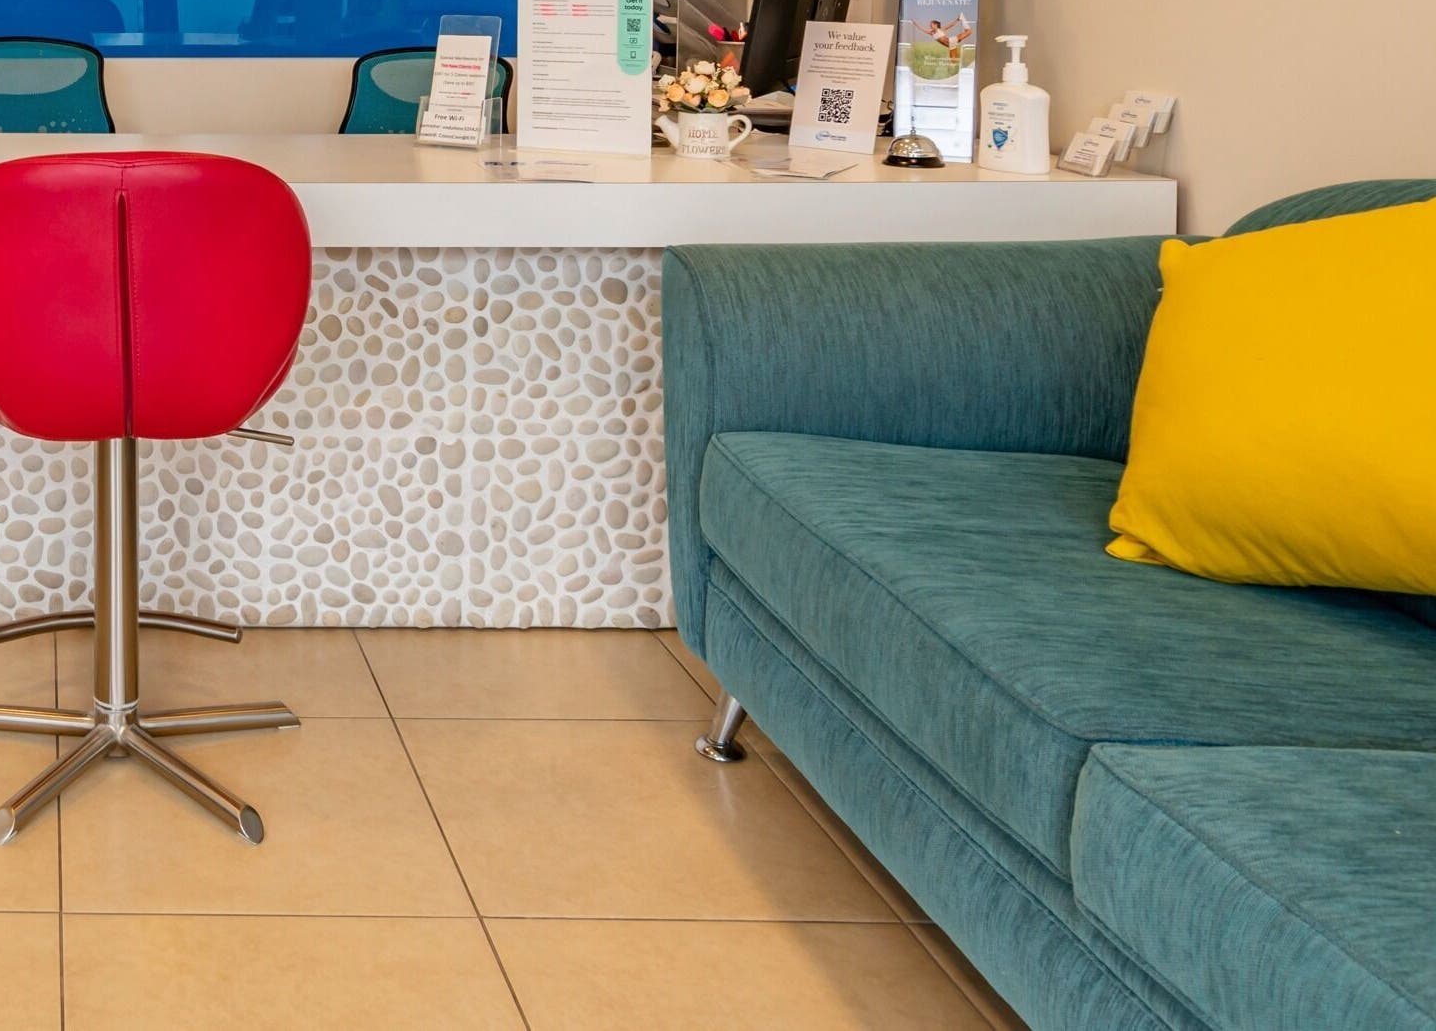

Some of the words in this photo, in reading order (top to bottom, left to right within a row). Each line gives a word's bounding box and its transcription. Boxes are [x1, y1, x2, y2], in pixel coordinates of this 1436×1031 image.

[828, 31, 841, 40] We
[843, 32, 866, 41] value
[813, 42, 833, 51] your
[835, 42, 876, 51] feedback
[434, 113, 447, 121] Free
[688, 130, 719, 139] HOME
